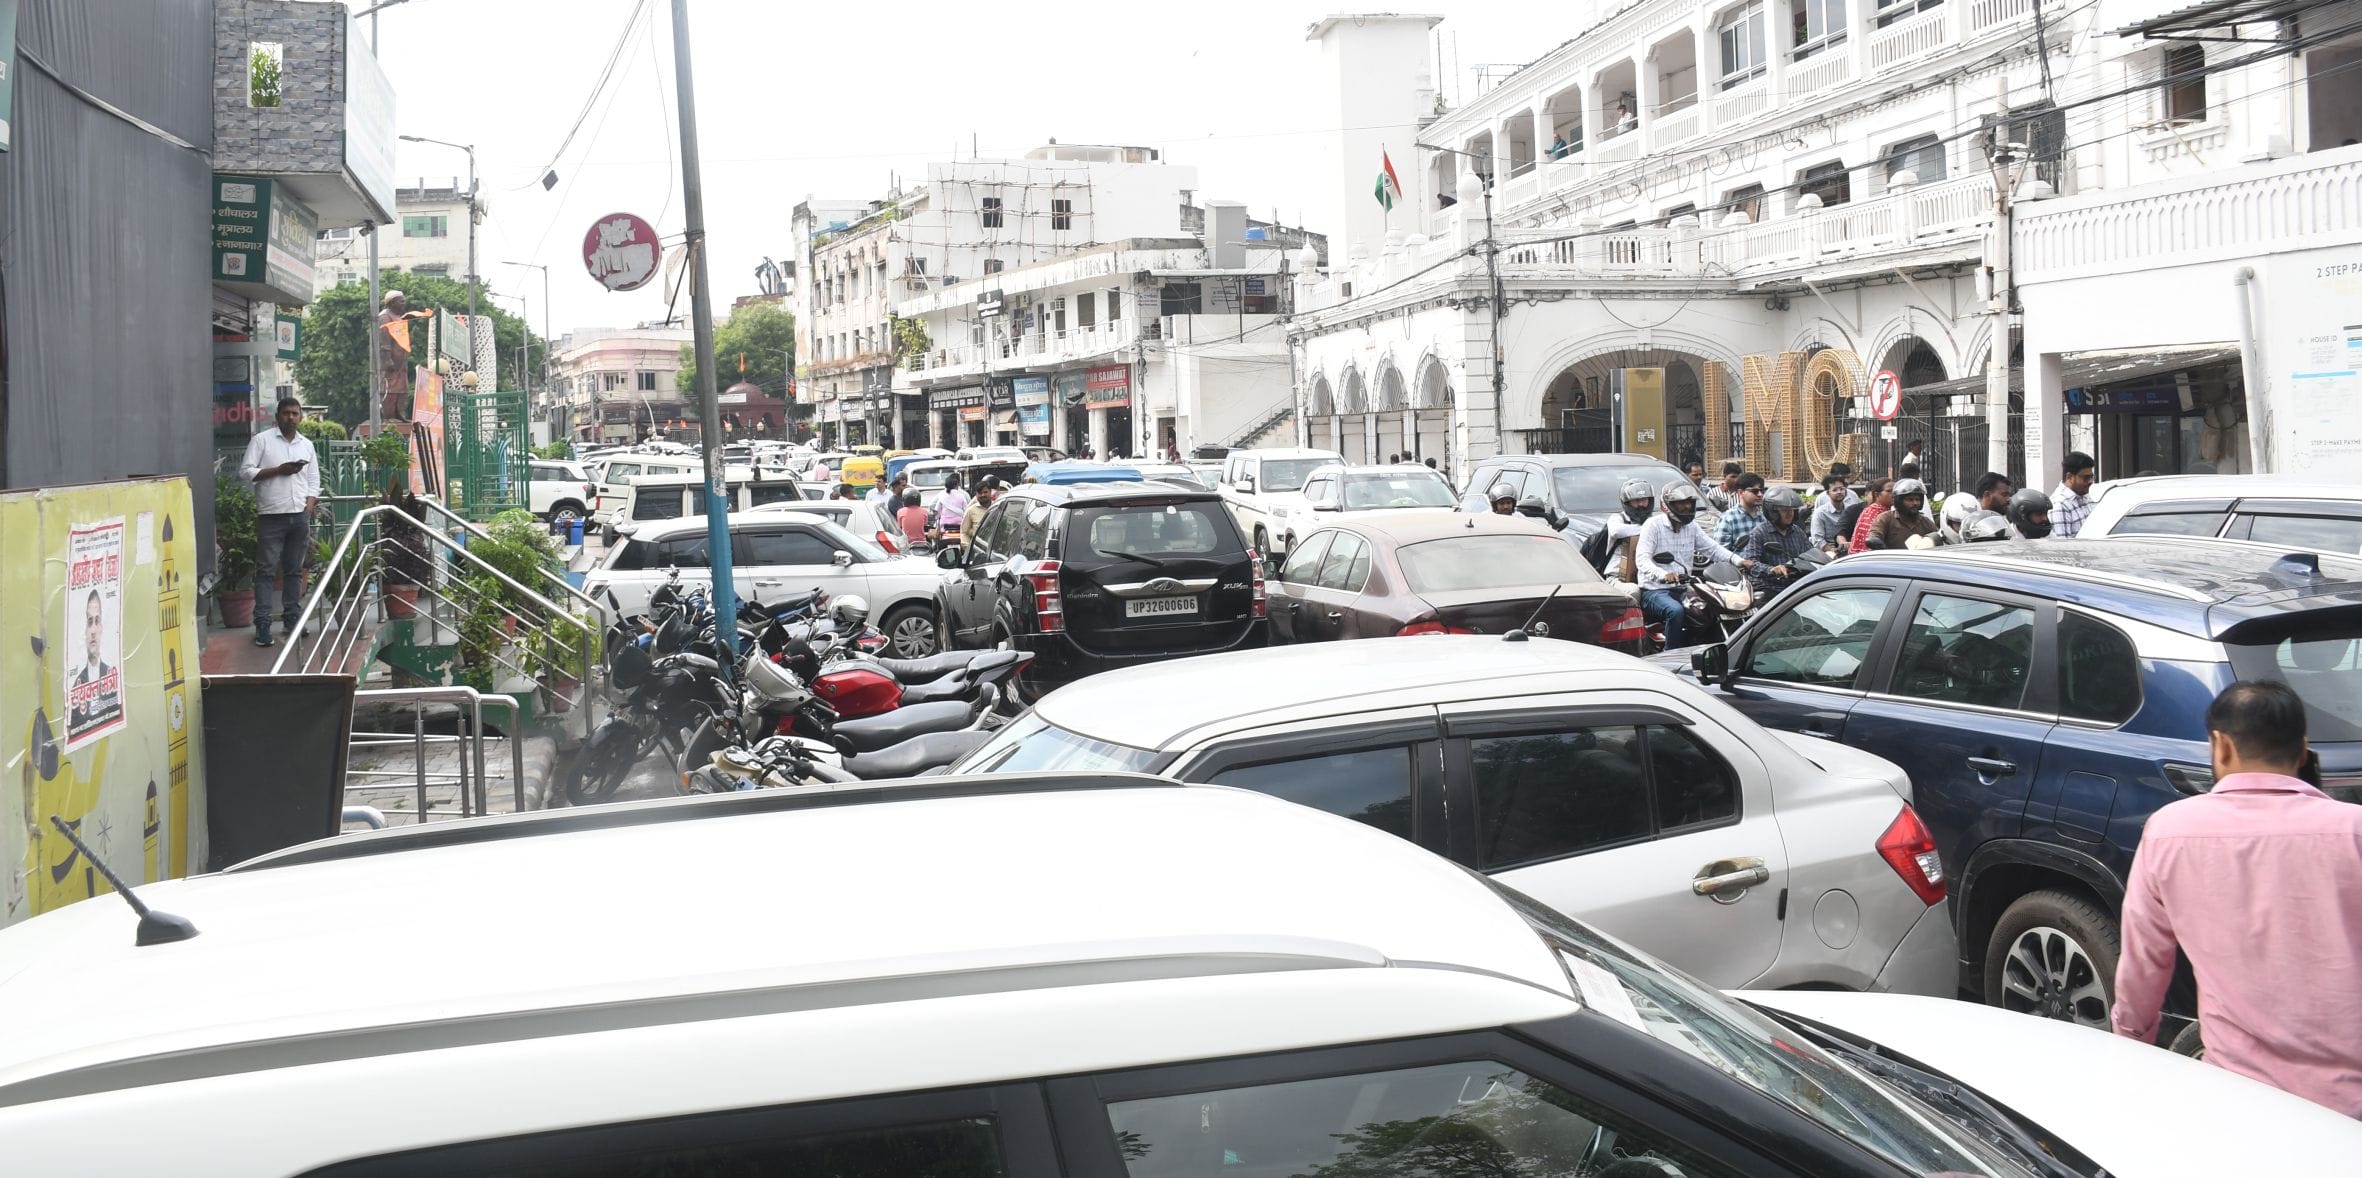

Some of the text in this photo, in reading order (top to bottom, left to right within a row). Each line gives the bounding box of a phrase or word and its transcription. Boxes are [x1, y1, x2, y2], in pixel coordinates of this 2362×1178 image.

[2316, 267, 2322, 278] 2
[2325, 264, 2348, 277] STEP
[1703, 348, 1872, 483] LMC
